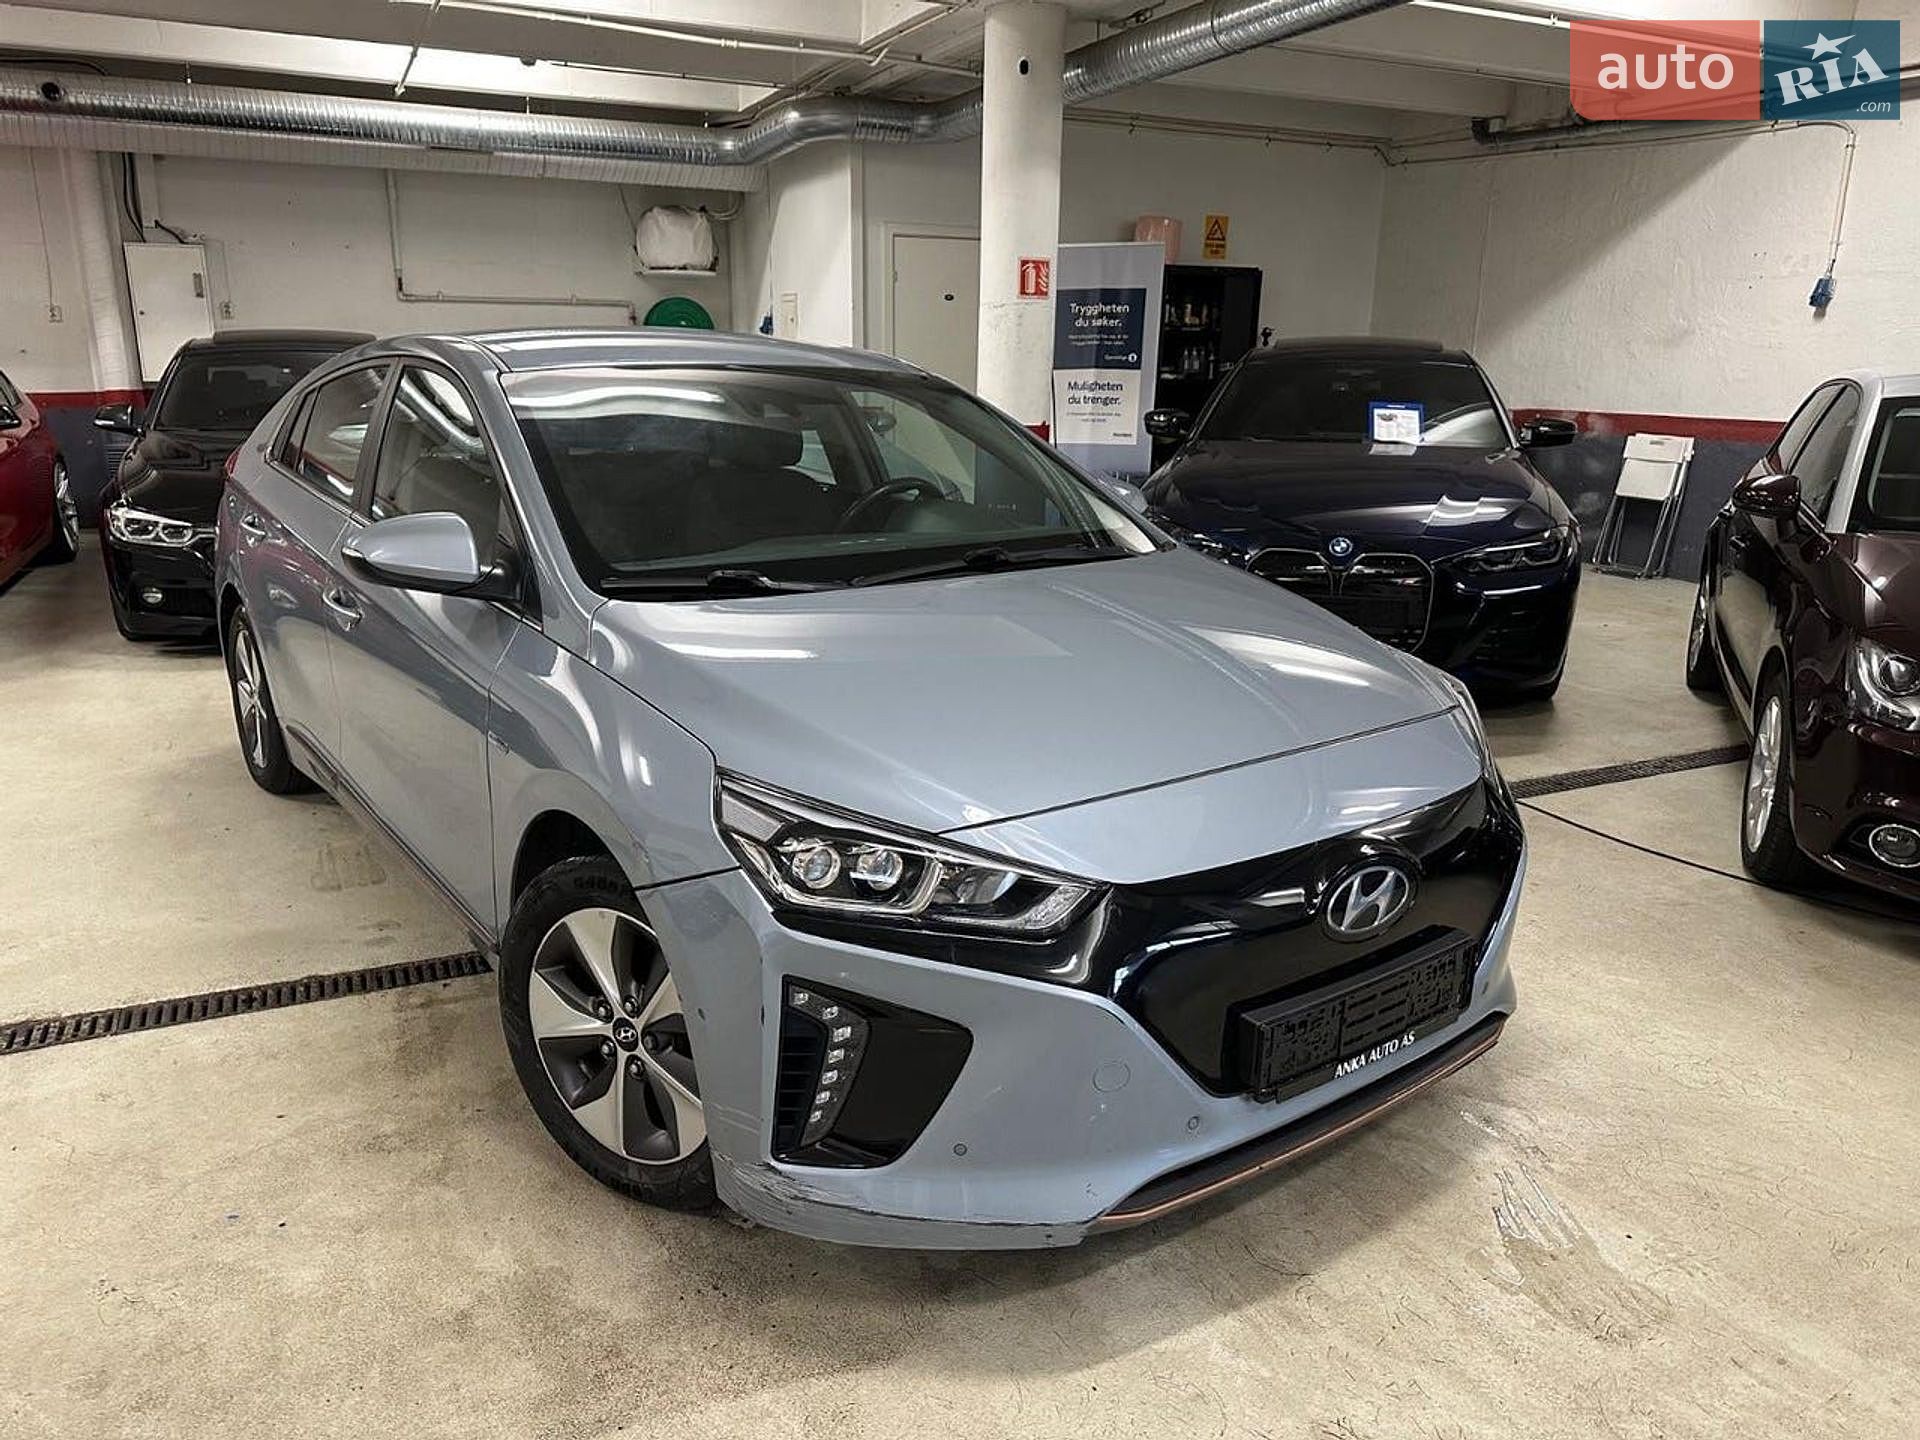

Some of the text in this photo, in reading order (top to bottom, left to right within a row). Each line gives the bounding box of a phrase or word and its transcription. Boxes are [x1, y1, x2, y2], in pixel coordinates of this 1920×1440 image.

[1070, 302, 1130, 316] Tryggheten
[1075, 315, 1122, 327] du søker.
[1067, 380, 1123, 393] Muligheten
[1068, 393, 1121, 406] du trenger.
[1334, 1030, 1416, 1079] ANKA AUTO AS
